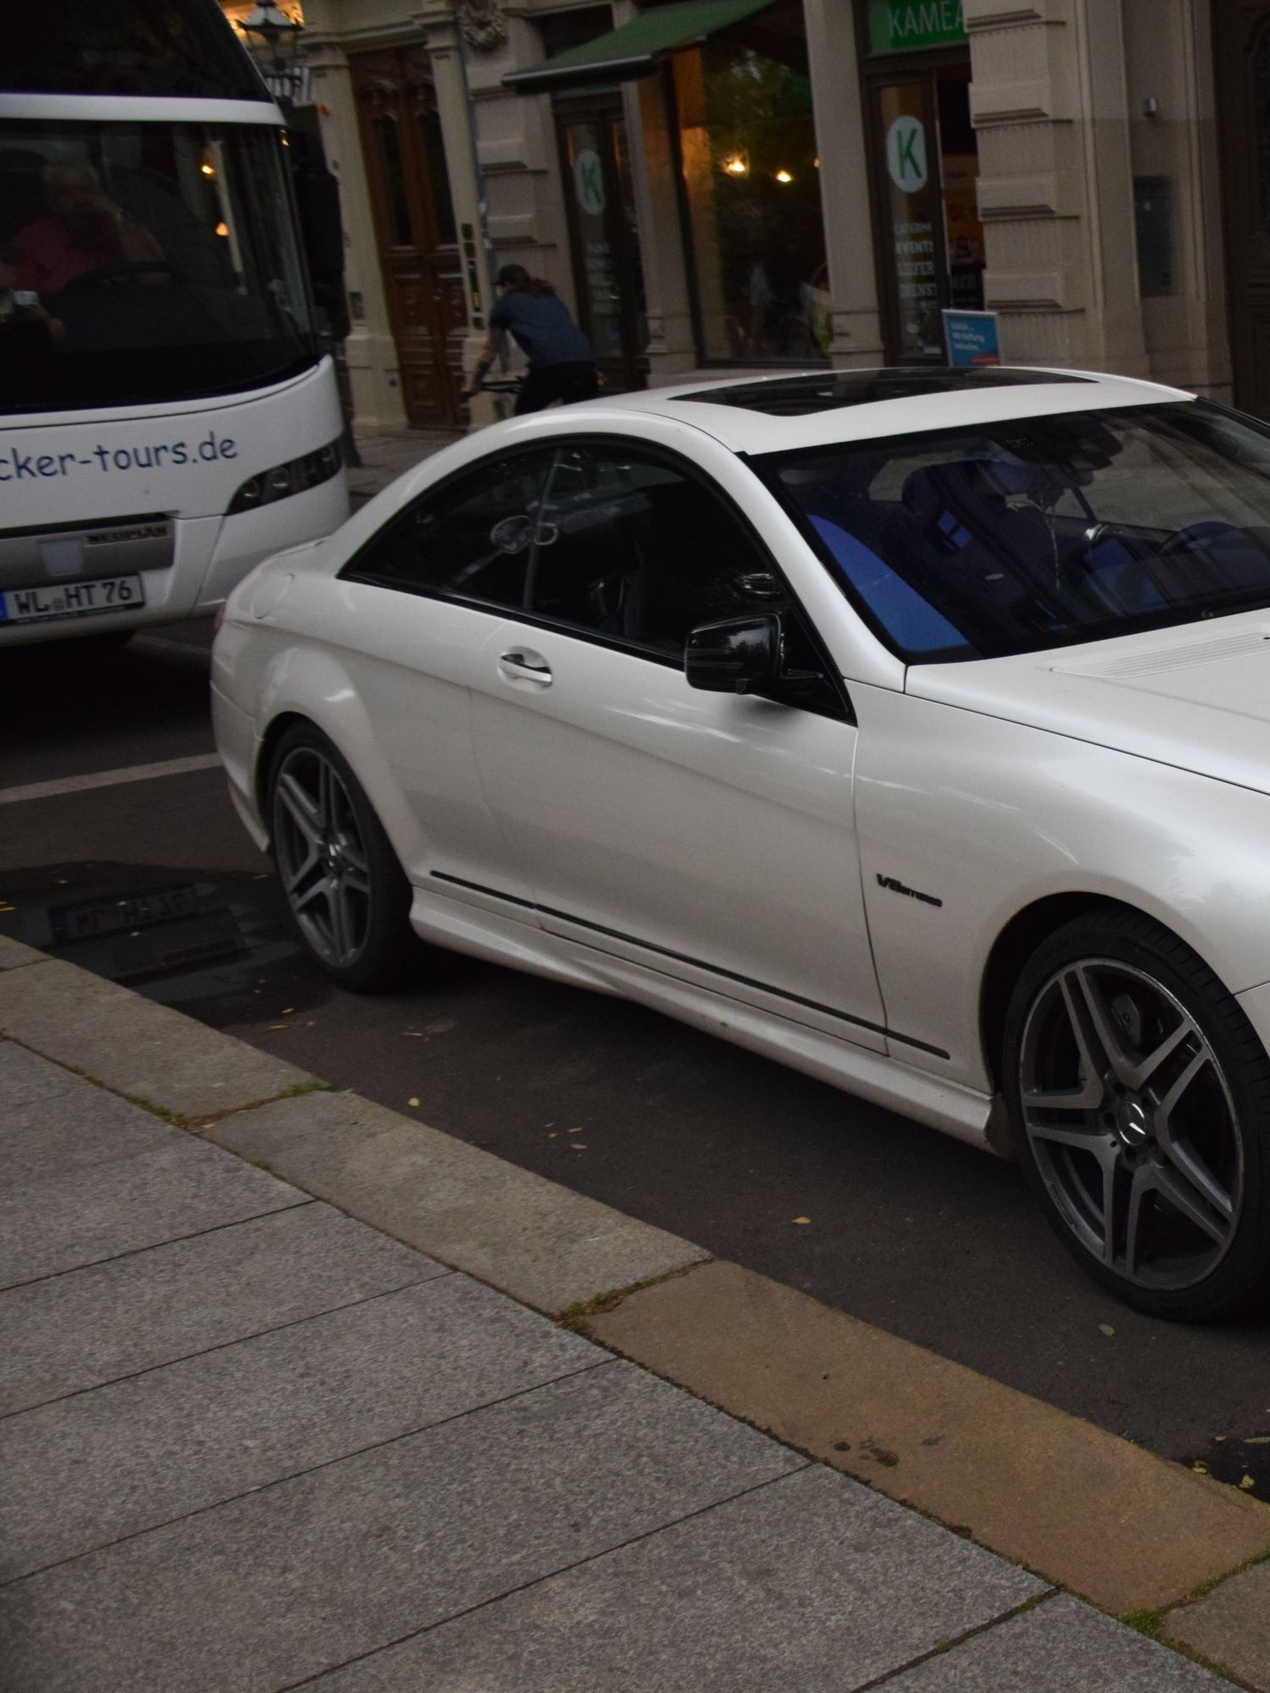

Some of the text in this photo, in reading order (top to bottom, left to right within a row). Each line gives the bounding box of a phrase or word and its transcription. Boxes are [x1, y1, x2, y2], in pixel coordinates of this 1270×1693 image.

[896, 127, 922, 180] K
[14, 580, 131, 615] WL HT 76
